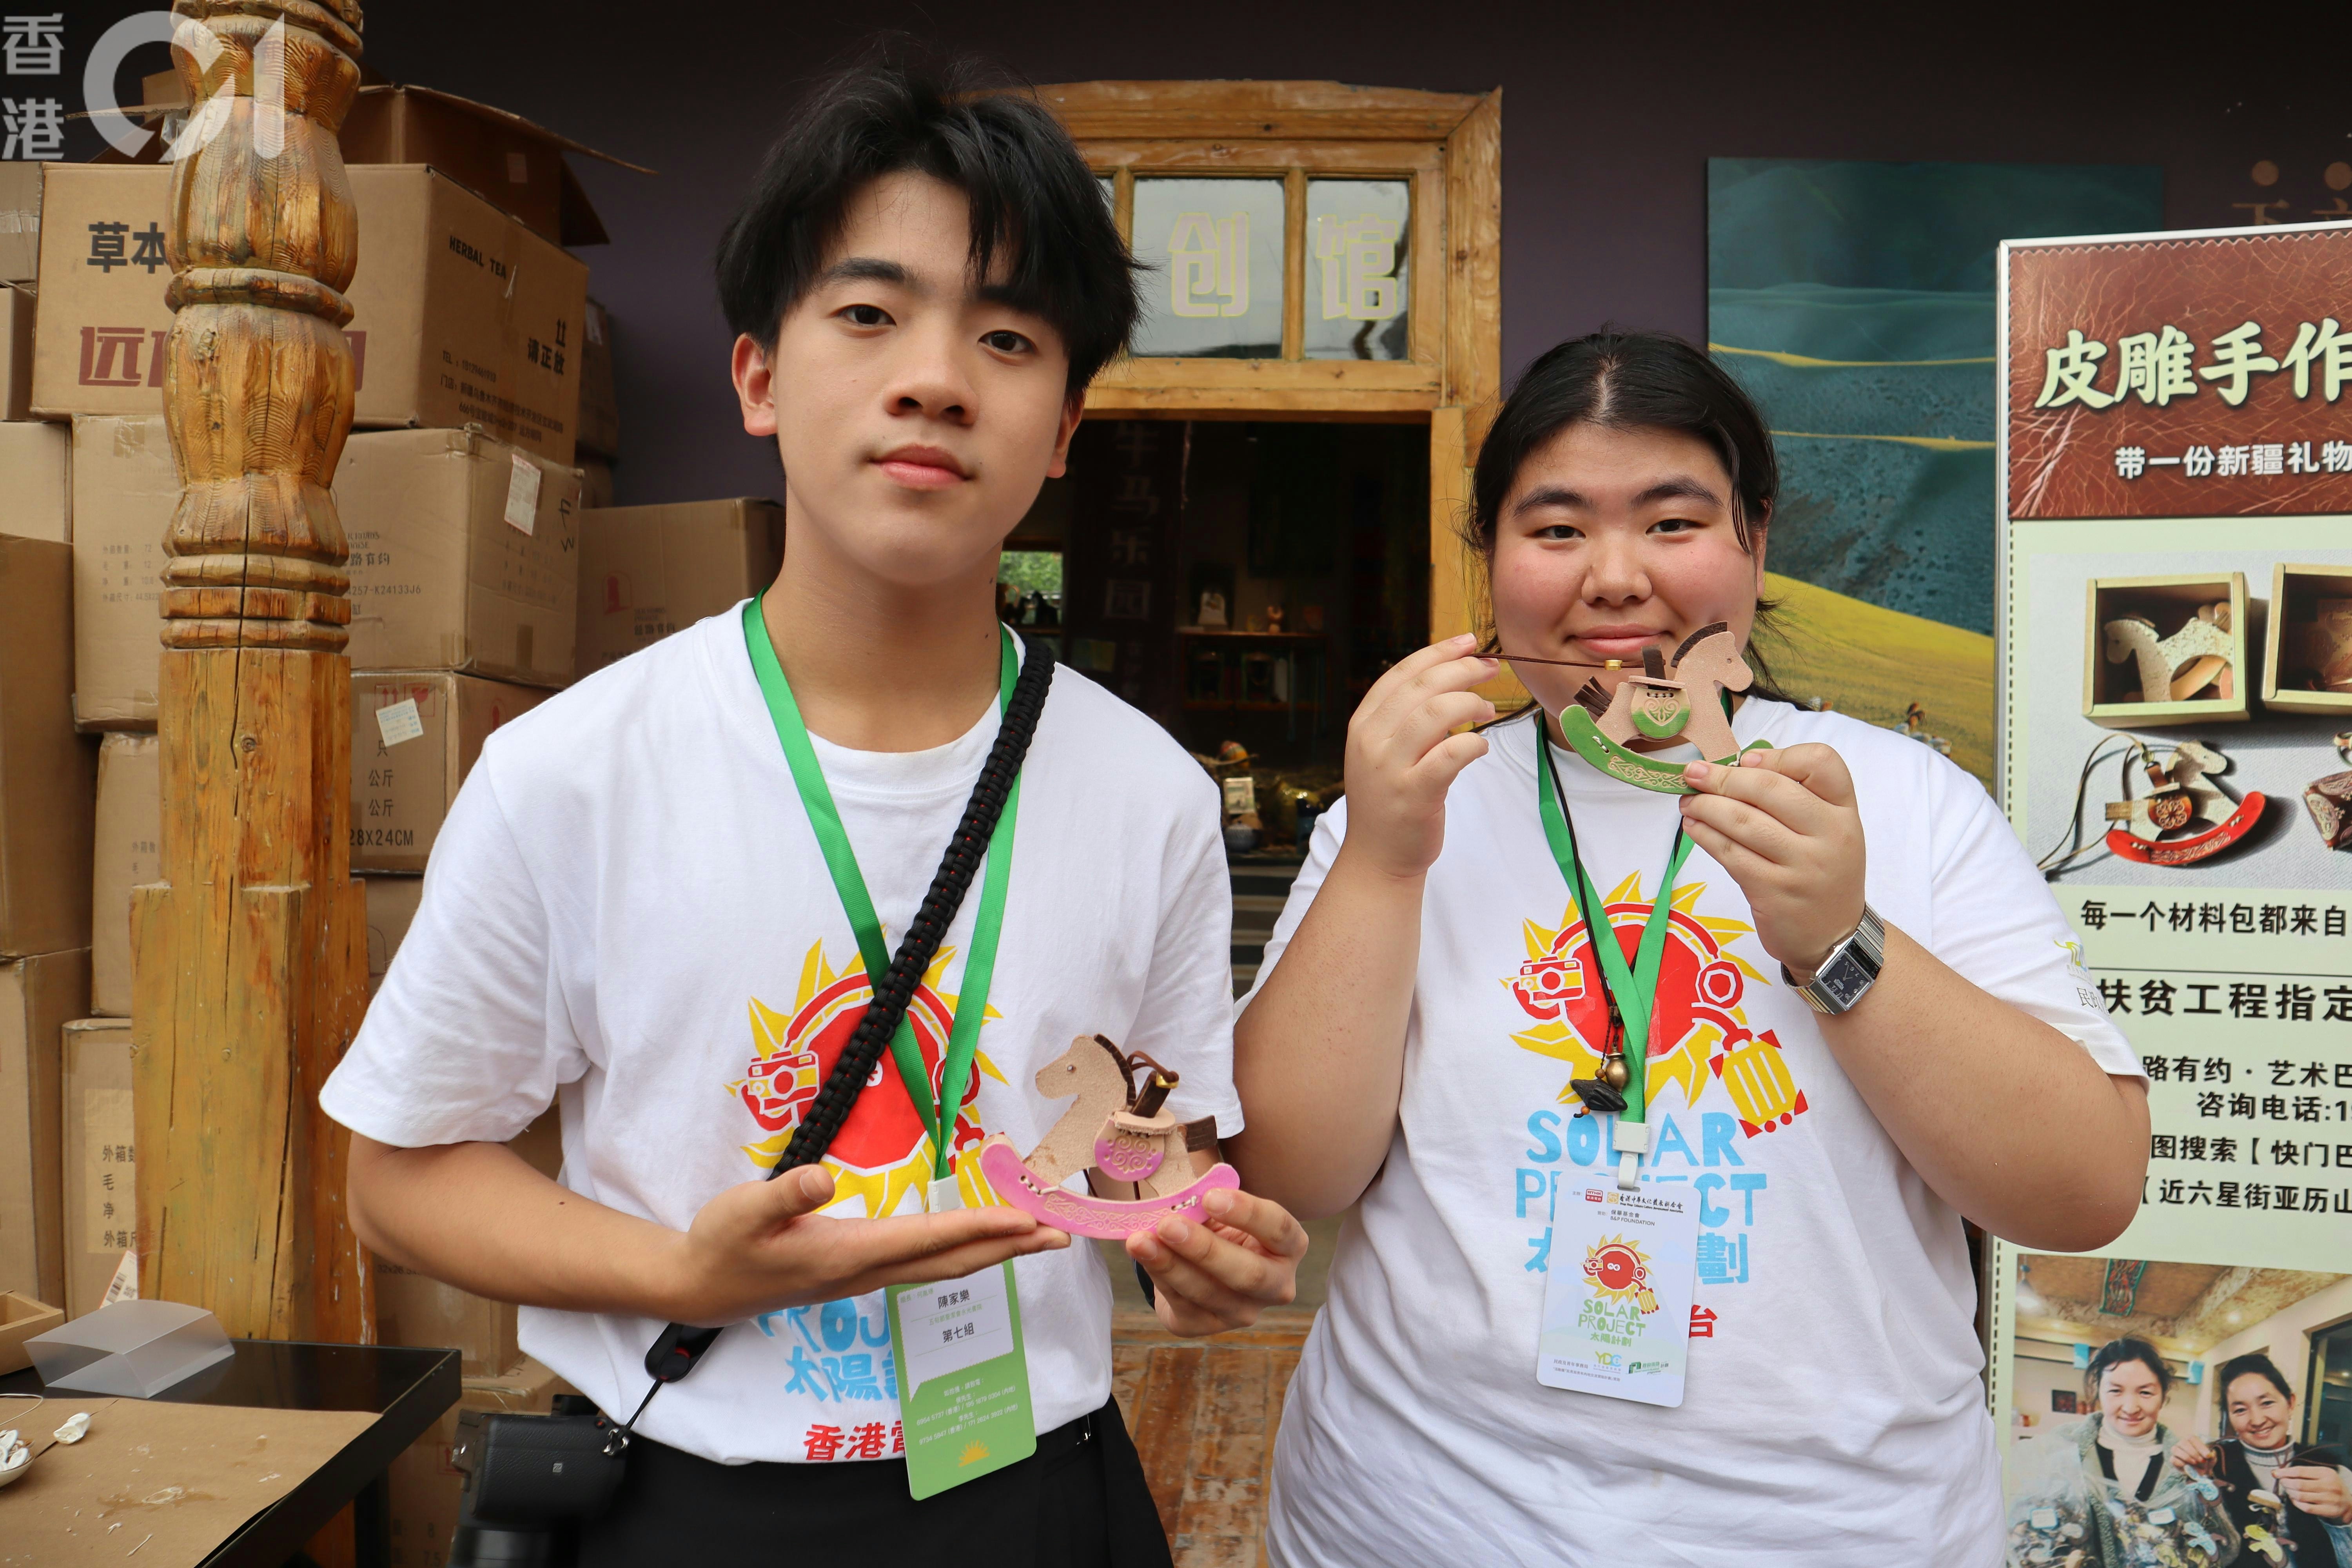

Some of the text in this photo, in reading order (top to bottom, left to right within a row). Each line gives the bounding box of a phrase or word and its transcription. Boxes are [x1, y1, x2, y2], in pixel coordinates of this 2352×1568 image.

[449, 236, 506, 280] HERBAL TEA
[527, 337, 565, 376] 请正放
[2034, 317, 2352, 409] 皮雕手作
[2114, 440, 2352, 479] 带一份新疆礼物
[368, 769, 394, 787] 公斤
[368, 799, 394, 817] 公斤
[350, 829, 414, 847] 28X24CM
[2081, 899, 2347, 937] 每一个材料包都来自
[2096, 978, 2352, 1022] 扶贫工程指定
[2196, 1091, 2352, 1122] 咨询电话:1
[102, 1174, 114, 1192] 毛
[102, 1202, 114, 1219] 净
[1621, 1217, 1655, 1226] FOUNDATION
[938, 1289, 971, 1309] 陳家樂
[1583, 1299, 1641, 1321] SOLAR
[942, 1322, 975, 1343] 第七組
[1578, 1313, 1646, 1337] PROJECT
[1590, 1332, 1632, 1347] 太陽計劃
